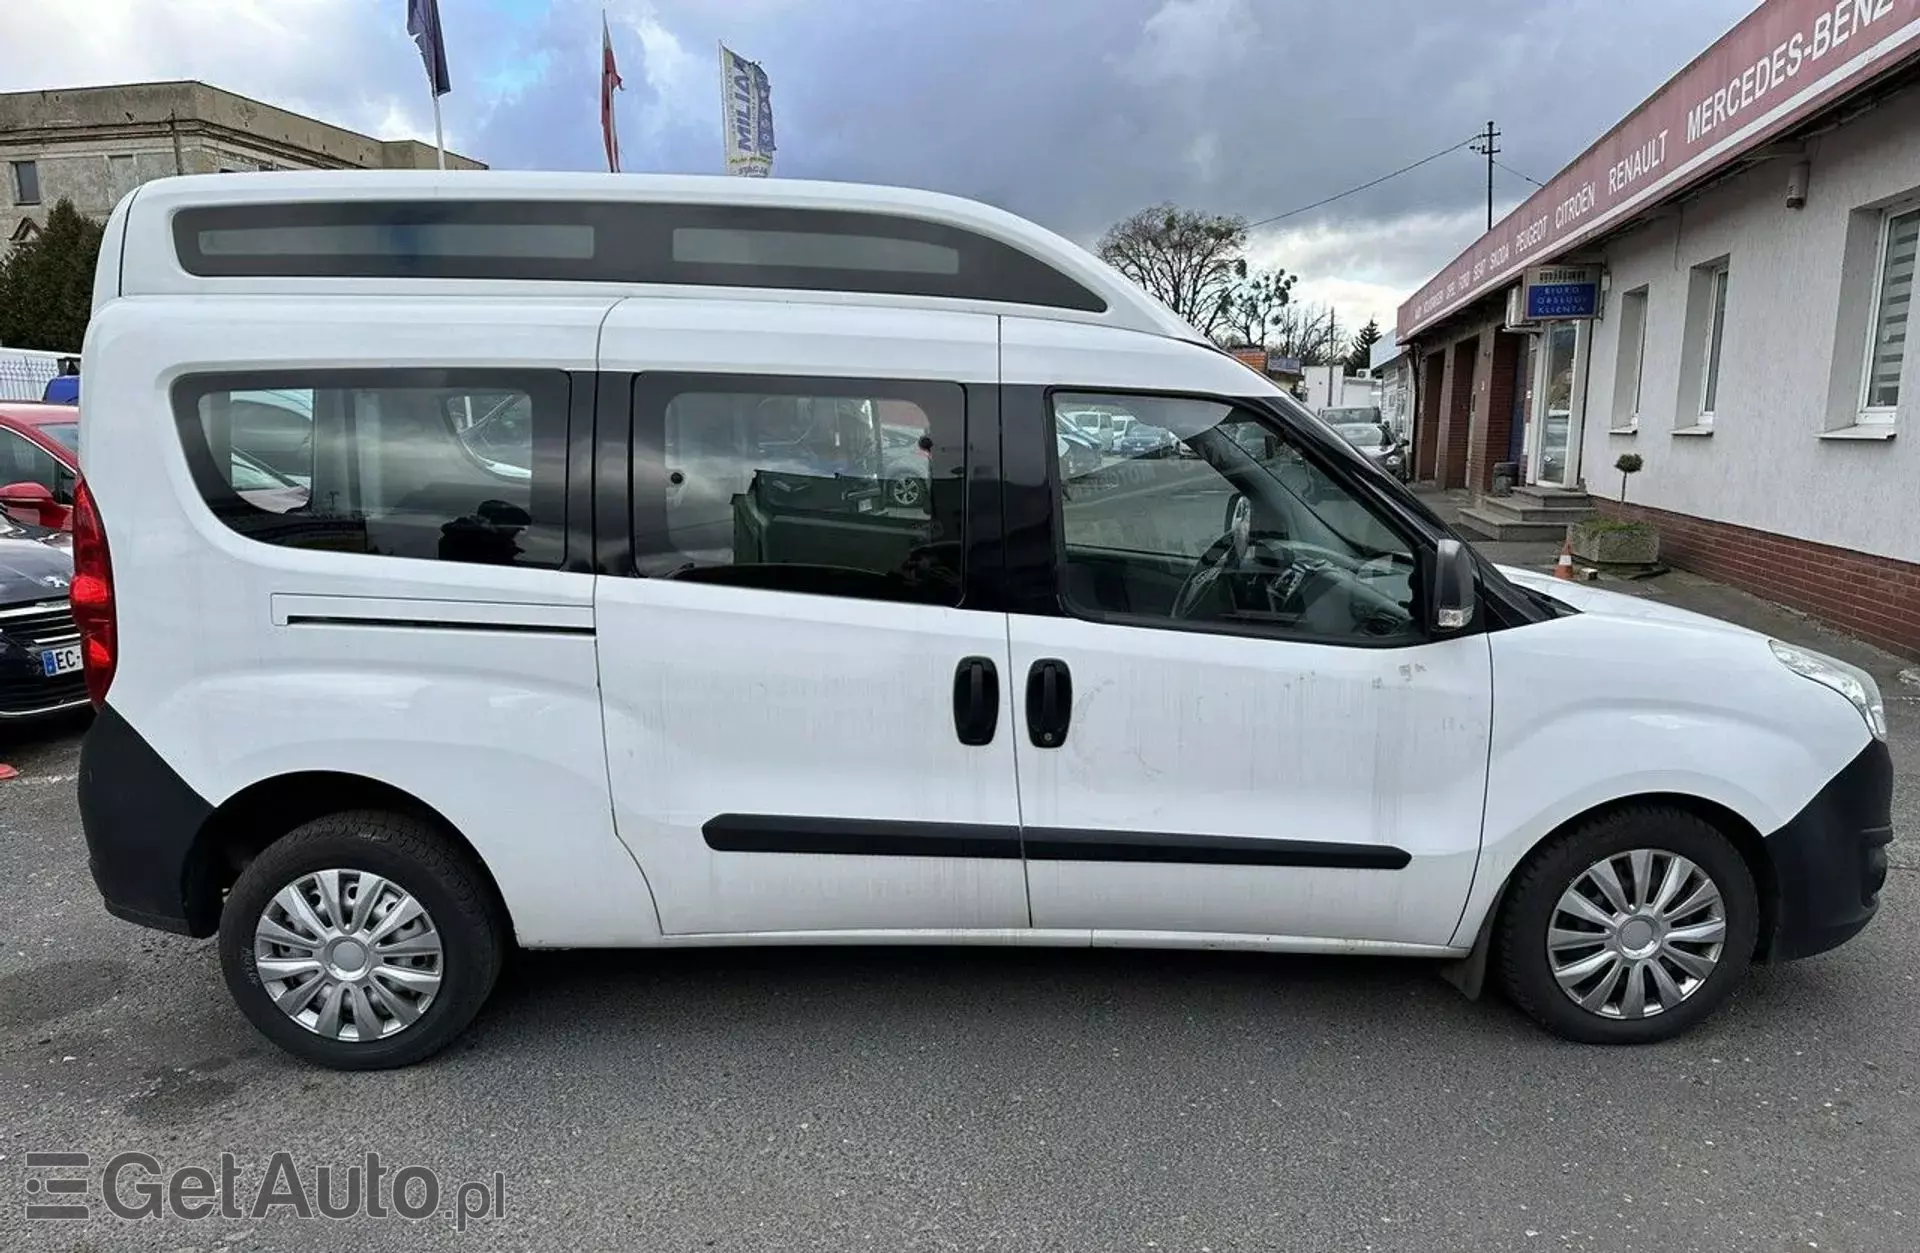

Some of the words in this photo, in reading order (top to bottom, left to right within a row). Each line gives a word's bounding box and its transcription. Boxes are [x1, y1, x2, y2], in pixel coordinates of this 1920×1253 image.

[1515, 214, 1548, 255] PEUGEOT
[1555, 181, 1596, 229] CITROËN
[1608, 128, 1668, 195] RENAULT
